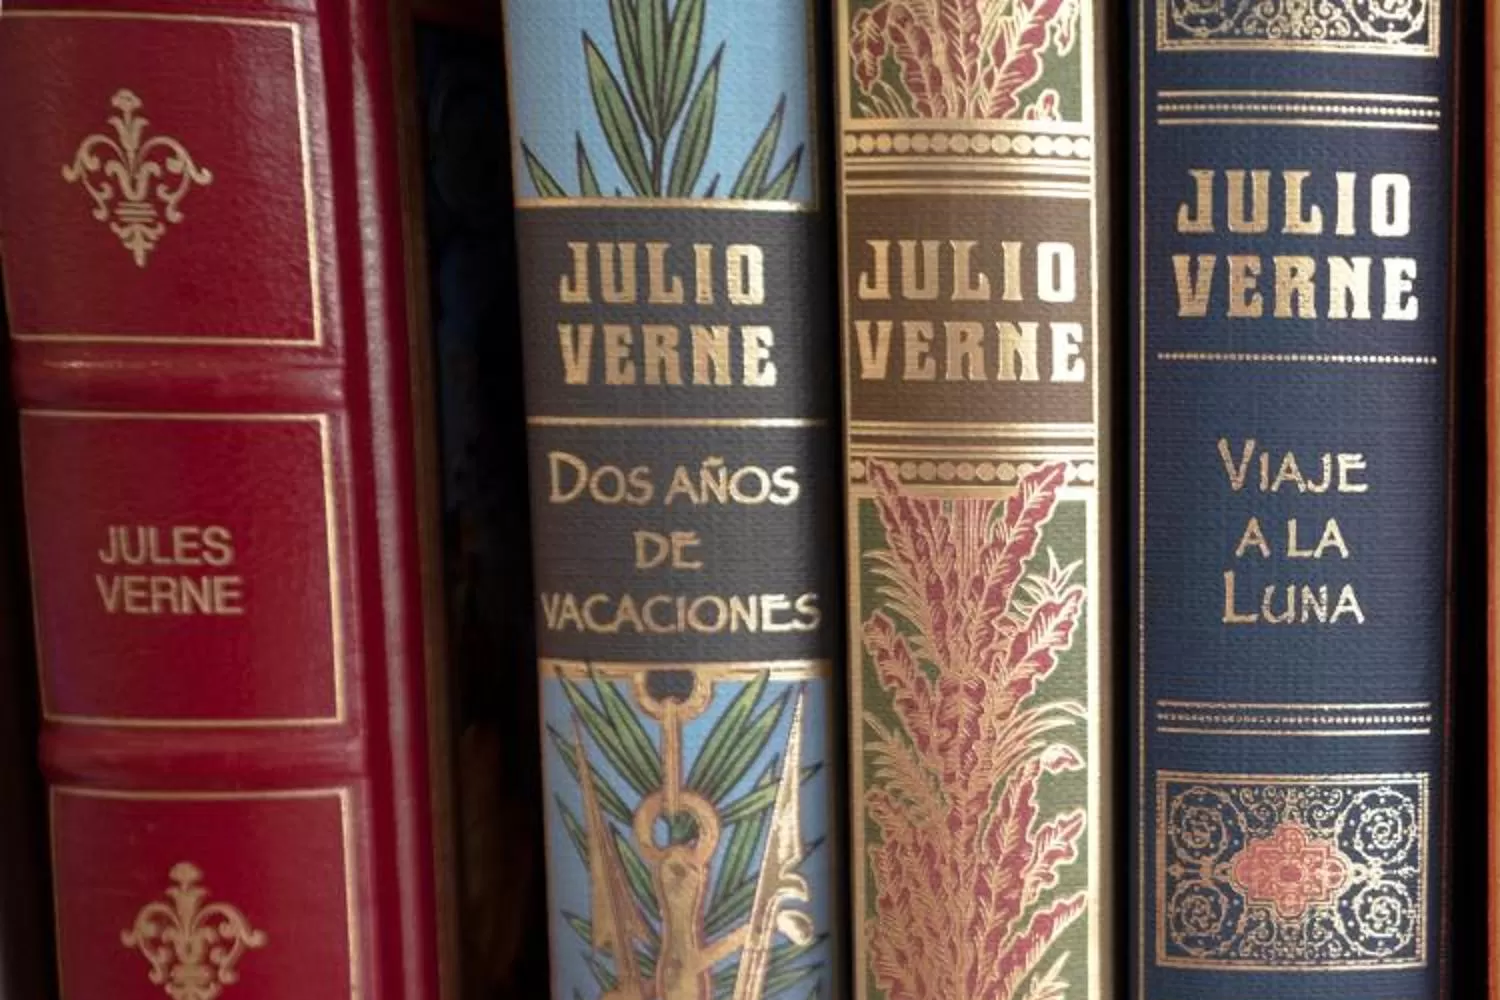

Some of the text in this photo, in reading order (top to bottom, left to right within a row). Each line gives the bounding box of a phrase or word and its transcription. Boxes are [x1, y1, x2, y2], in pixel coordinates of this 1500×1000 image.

[1176, 168, 1411, 237] JULIO
[559, 240, 767, 306] JULIO
[857, 239, 1077, 303] JULIO
[1172, 253, 1420, 321] VERNE
[557, 323, 778, 387] VERNE
[853, 319, 1086, 383] VERNE
[546, 451, 801, 506] DOS AÑOS
[1216, 437, 1370, 493] VIAJE
[98, 525, 234, 566] JULES
[632, 529, 704, 569] DE
[1235, 516, 1350, 559] A LA
[96, 575, 243, 614] VERNE
[540, 592, 822, 636] VACACIONES
[1221, 569, 1365, 624] LUNA
